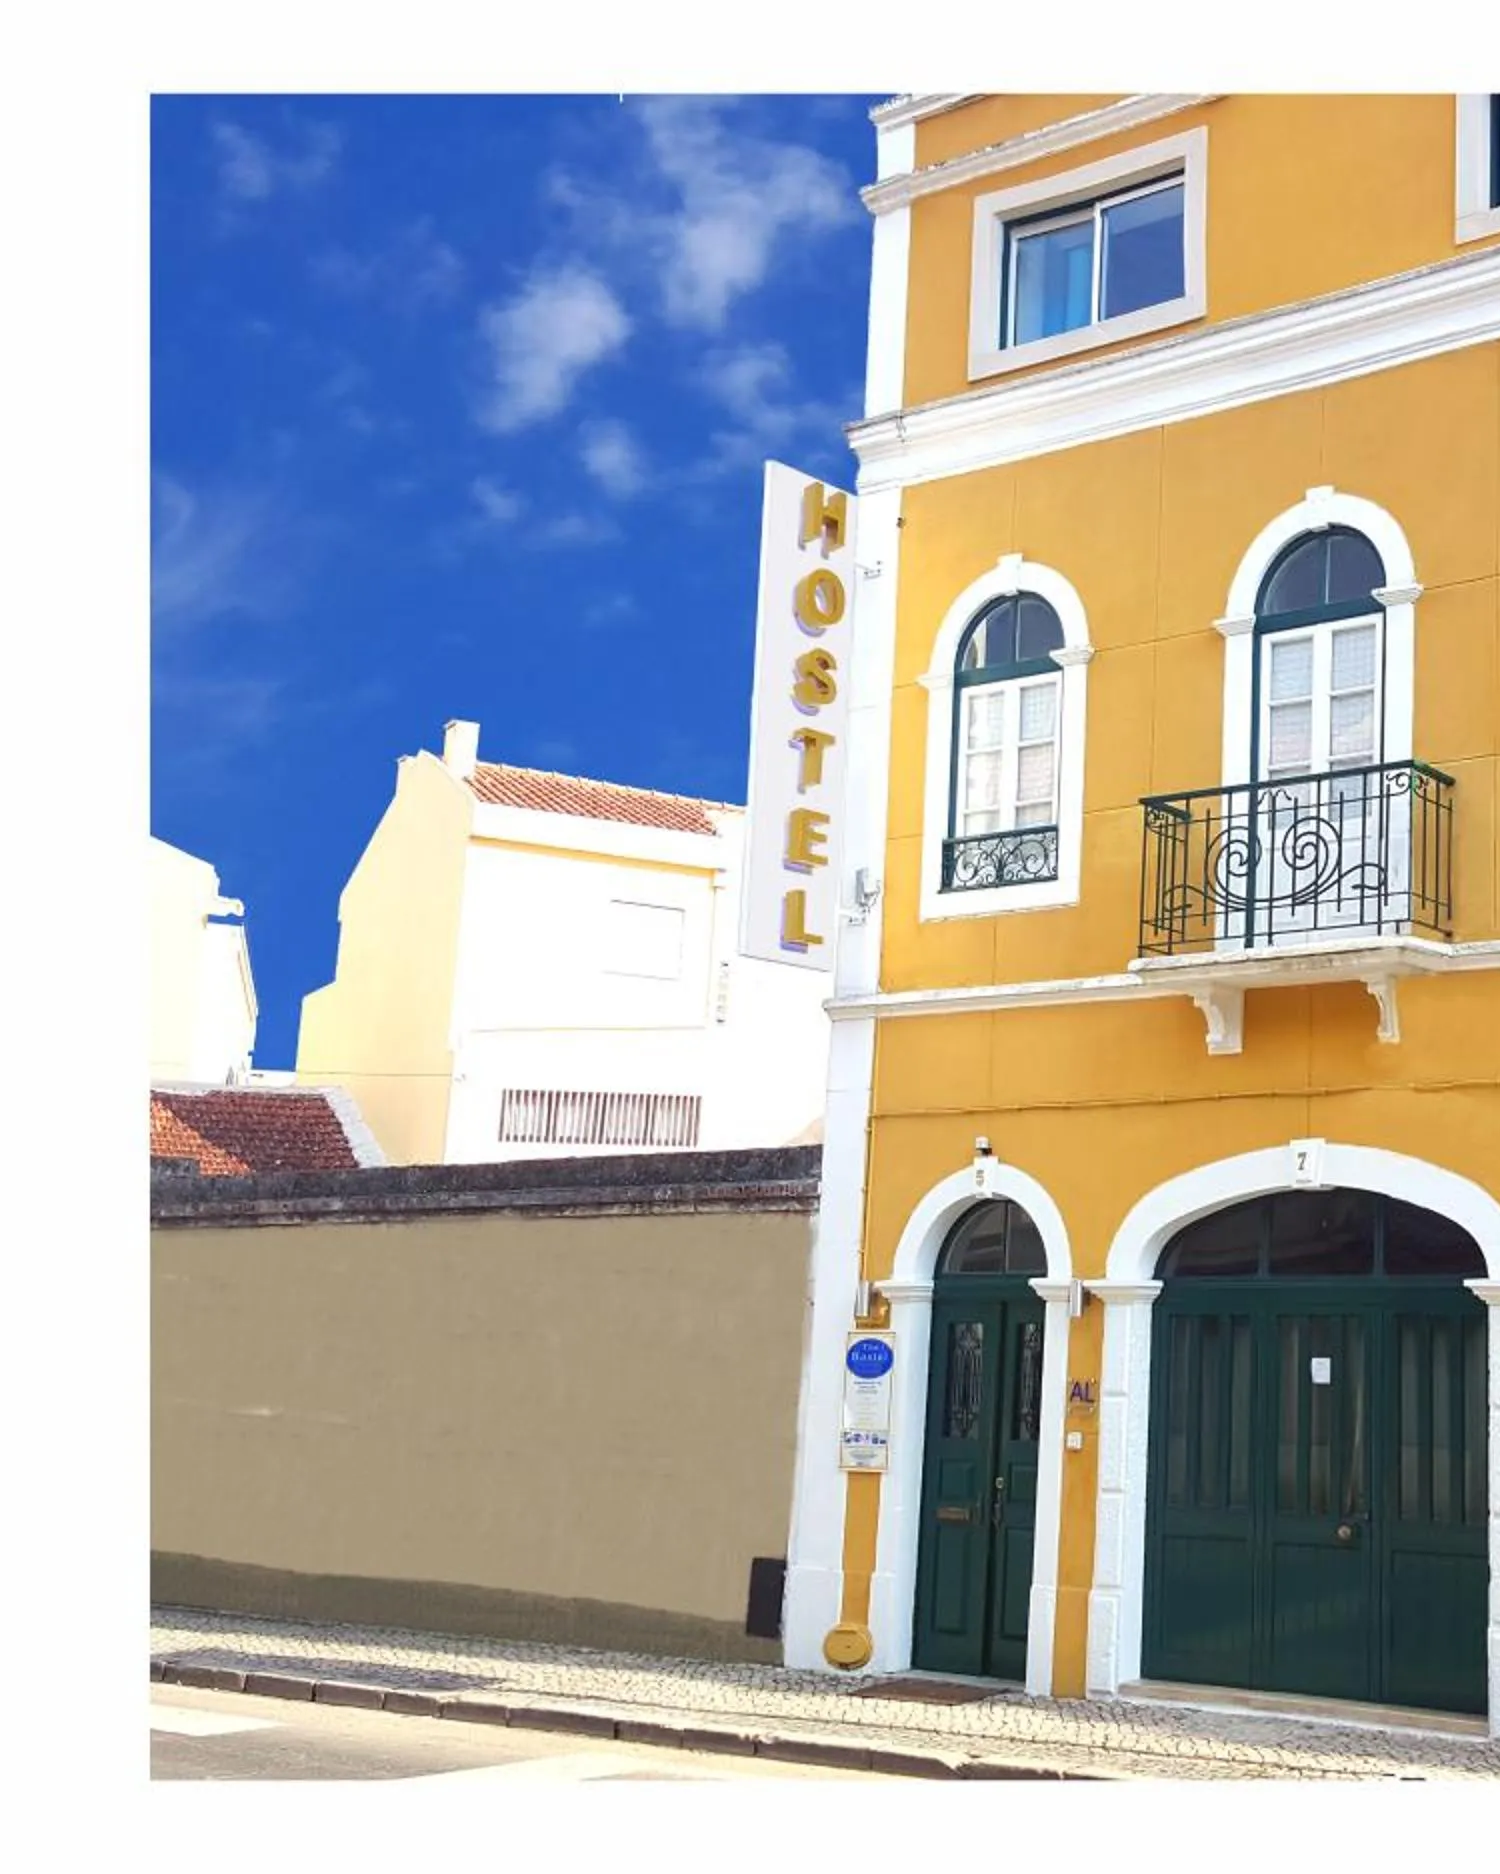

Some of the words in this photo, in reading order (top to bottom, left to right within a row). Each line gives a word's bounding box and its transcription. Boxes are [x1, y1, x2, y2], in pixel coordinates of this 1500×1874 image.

[783, 479, 847, 950] HOSTEL
[1296, 1151, 1308, 1171] 7
[1069, 1381, 1095, 1403] AL
